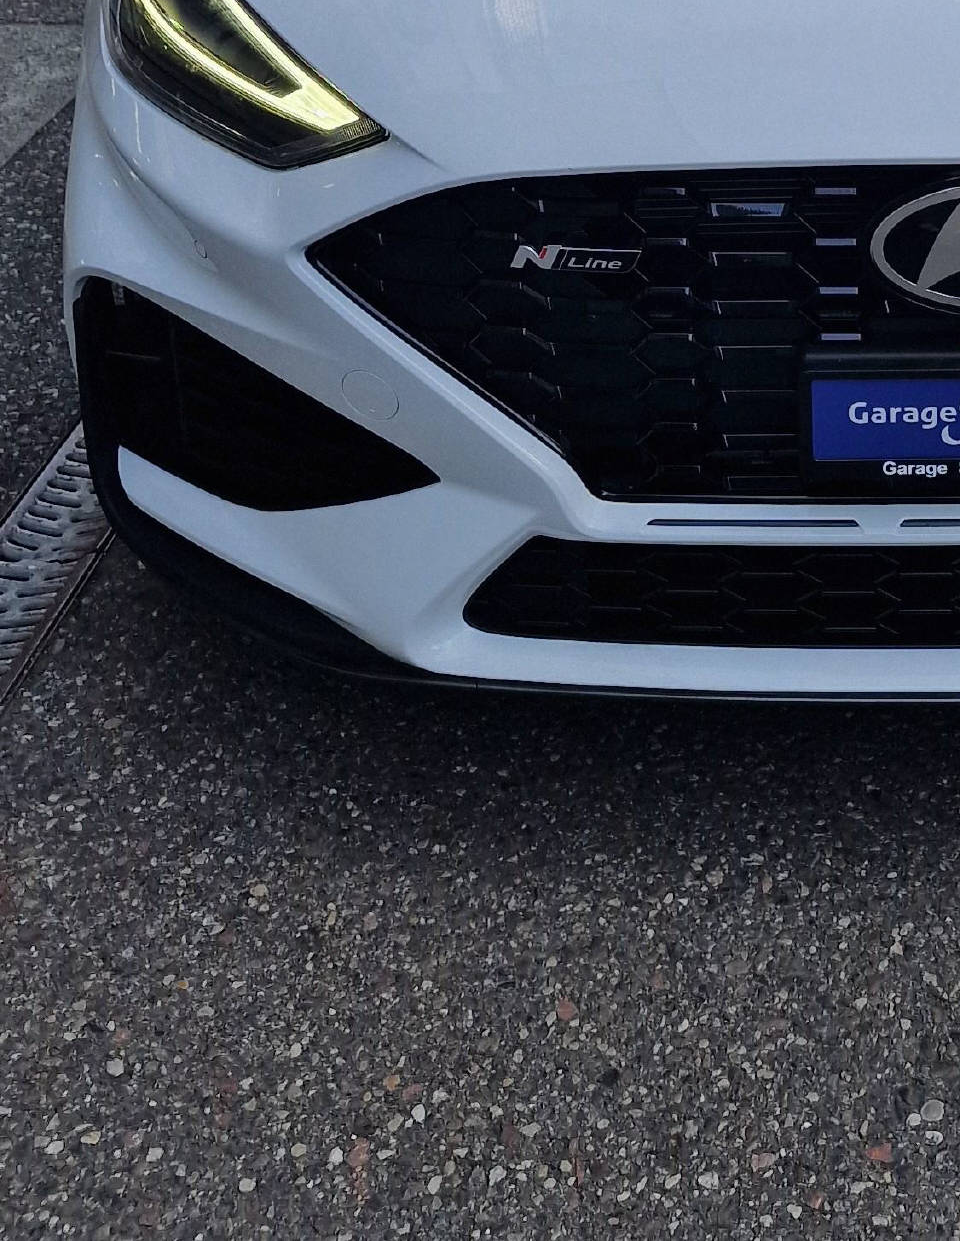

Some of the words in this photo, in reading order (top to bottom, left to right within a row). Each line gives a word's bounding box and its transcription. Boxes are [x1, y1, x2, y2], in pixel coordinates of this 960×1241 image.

[510, 244, 562, 269] N
[567, 257, 622, 269] Line
[848, 401, 956, 429] Garage
[883, 460, 948, 477] Garage
